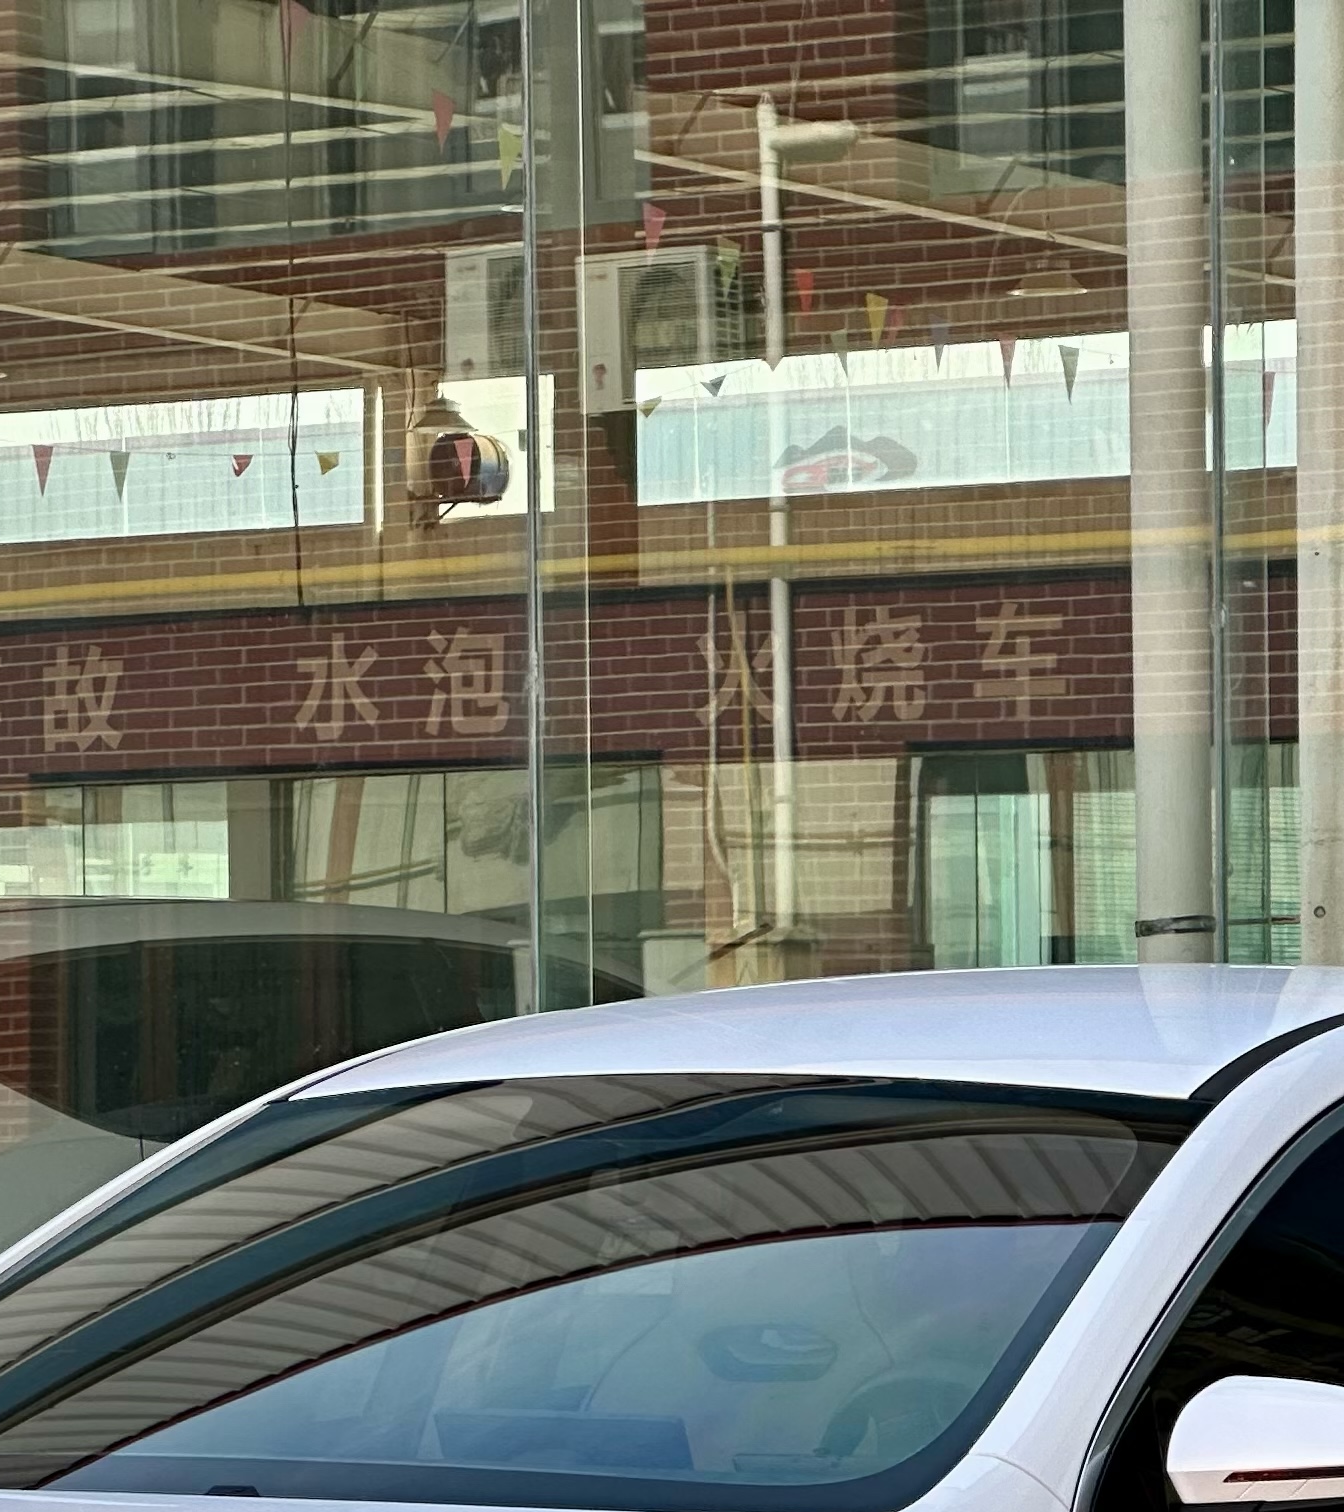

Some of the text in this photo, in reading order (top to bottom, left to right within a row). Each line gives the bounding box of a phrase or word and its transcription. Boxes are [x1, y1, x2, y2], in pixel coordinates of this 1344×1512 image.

[294, 625, 509, 740] 水泡
[695, 603, 1066, 727] 火烧车
